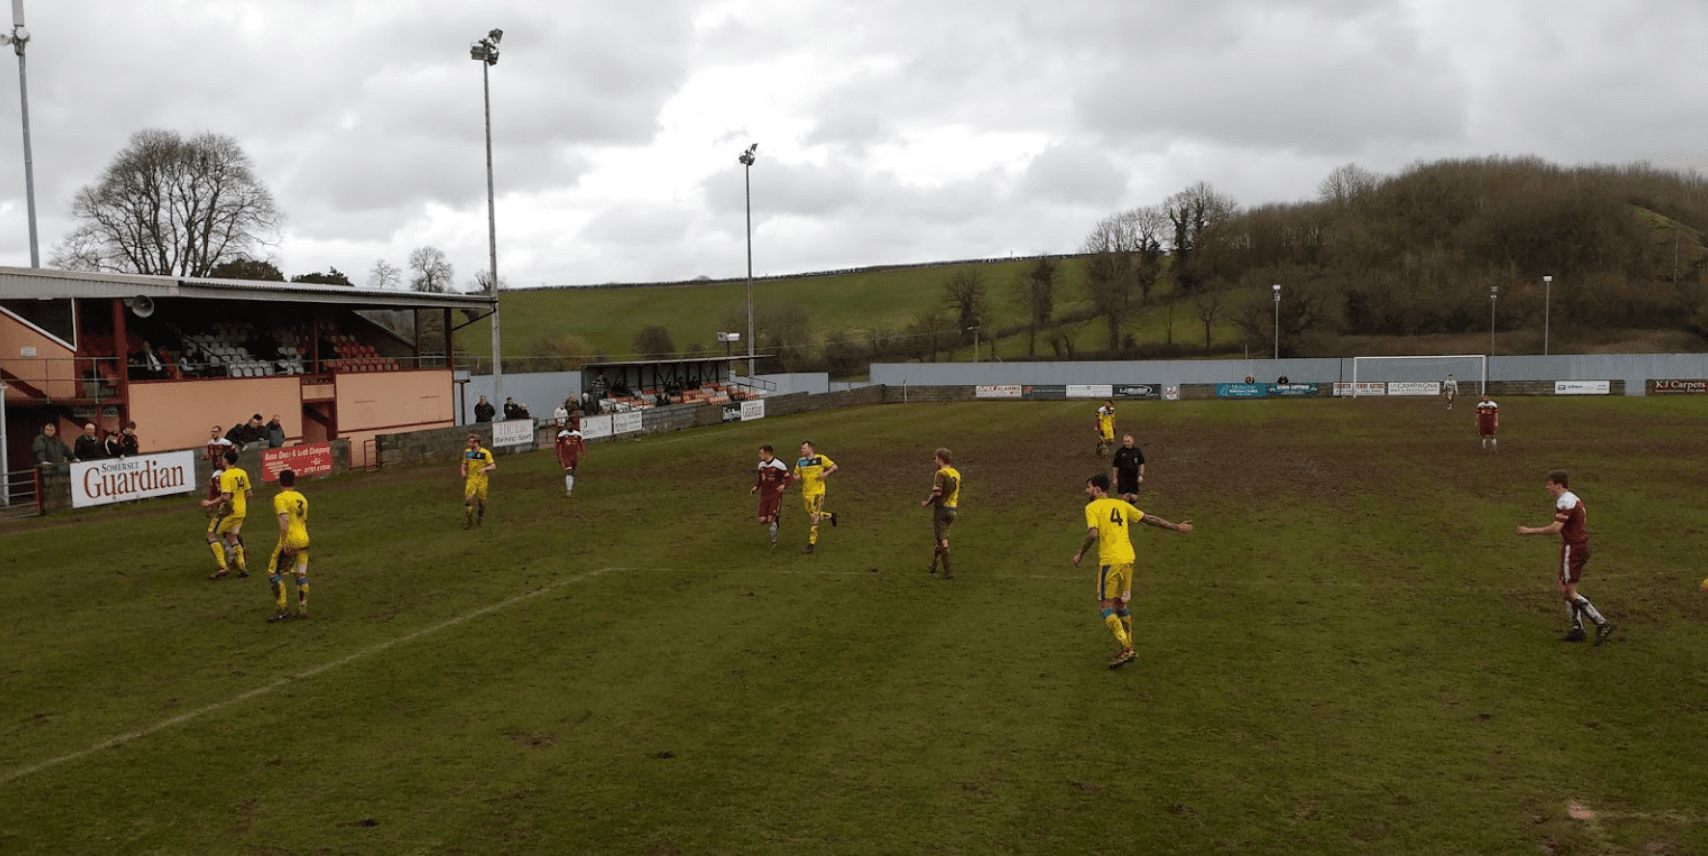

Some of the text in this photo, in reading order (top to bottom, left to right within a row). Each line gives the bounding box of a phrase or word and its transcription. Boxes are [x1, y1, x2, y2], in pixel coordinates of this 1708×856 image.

[1671, 380, 1706, 389] Carpets
[309, 446, 331, 457] Company
[101, 461, 139, 473] SOMERSET
[83, 460, 185, 499] Guardian
[296, 499, 304, 517] 3
[1110, 507, 1124, 527] 4
